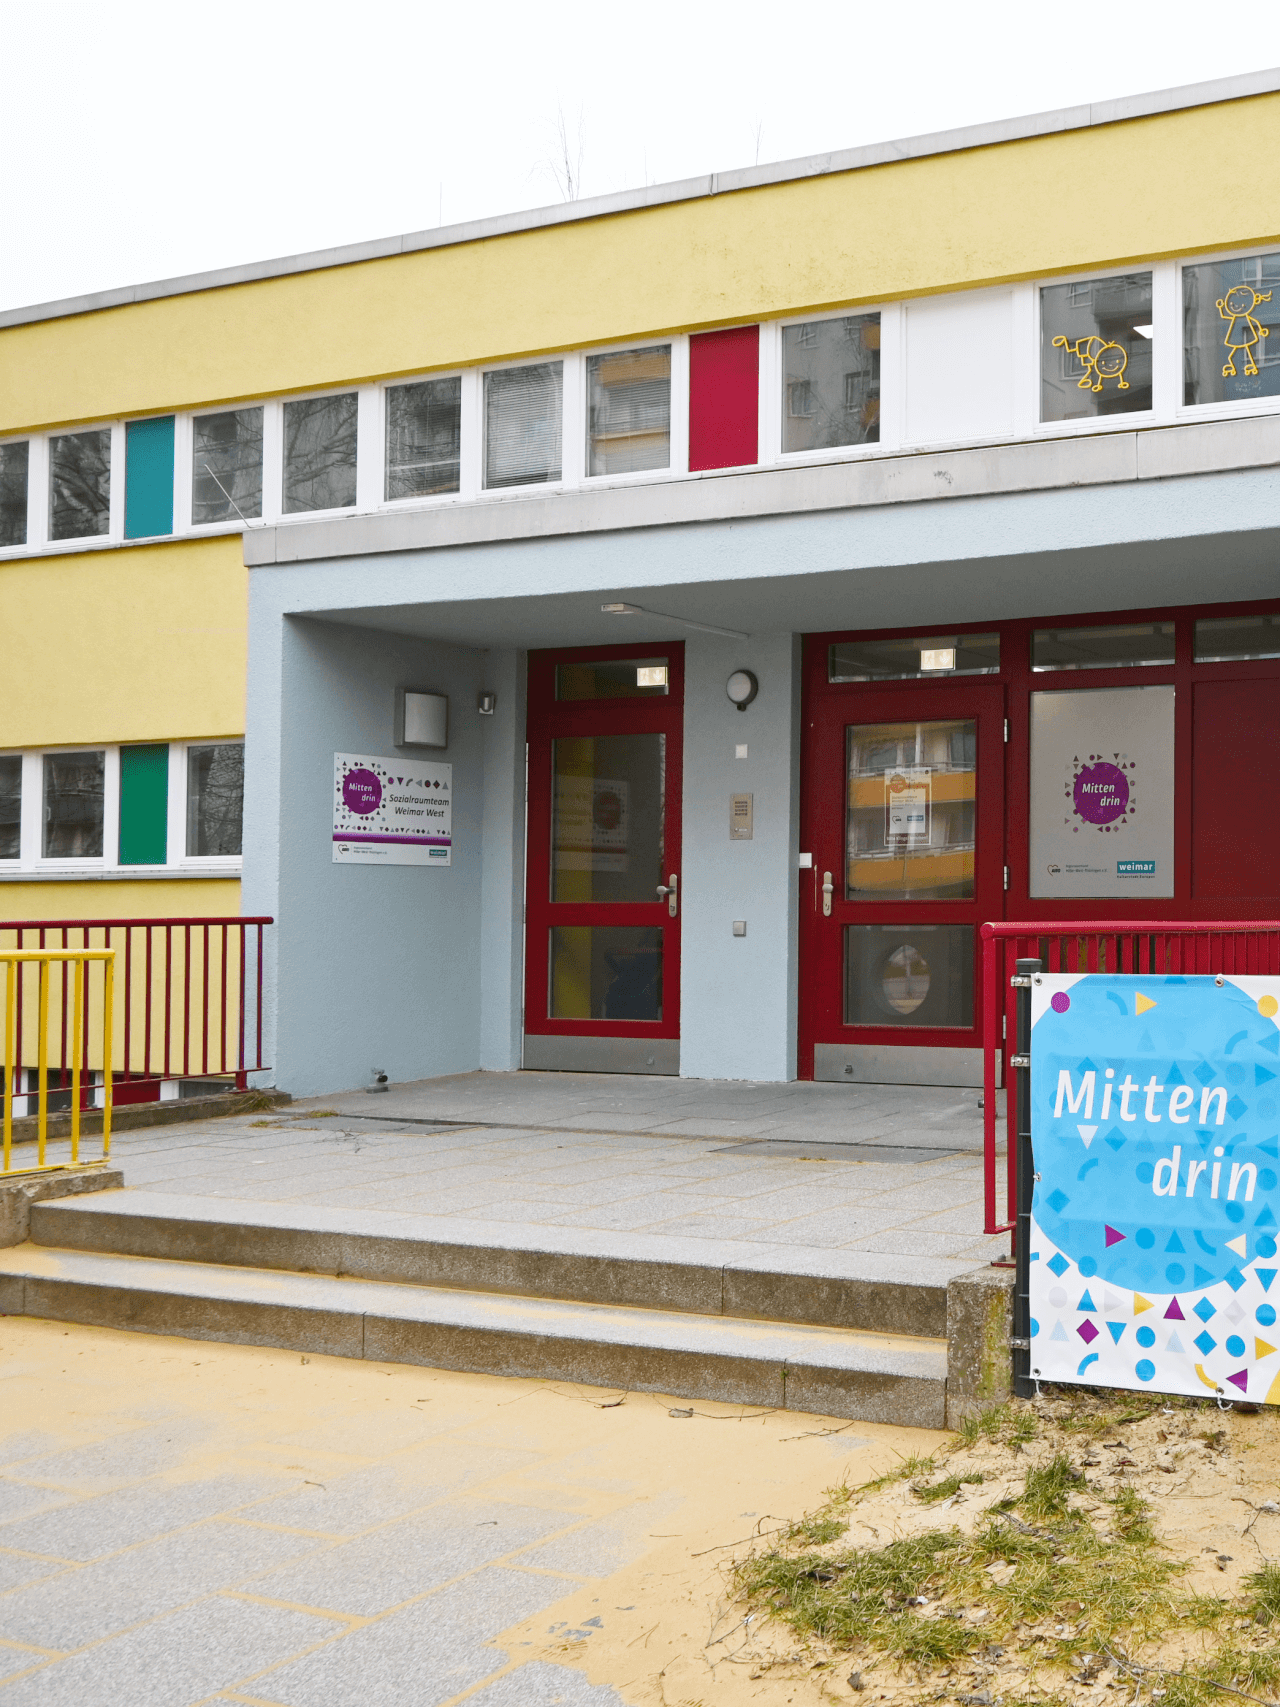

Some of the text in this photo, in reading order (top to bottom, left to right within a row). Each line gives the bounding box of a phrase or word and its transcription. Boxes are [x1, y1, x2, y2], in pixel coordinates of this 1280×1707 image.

[349, 782, 373, 792] Mitten
[1082, 782, 1115, 794] Mitten
[361, 793, 376, 802] drin
[389, 794, 450, 806] Sozialraumteam
[1100, 795, 1121, 807] drin
[394, 806, 445, 818] Weimar West
[1119, 862, 1154, 871] weimar
[1052, 1067, 1229, 1126] Mitten
[1151, 1144, 1259, 1202] drin
